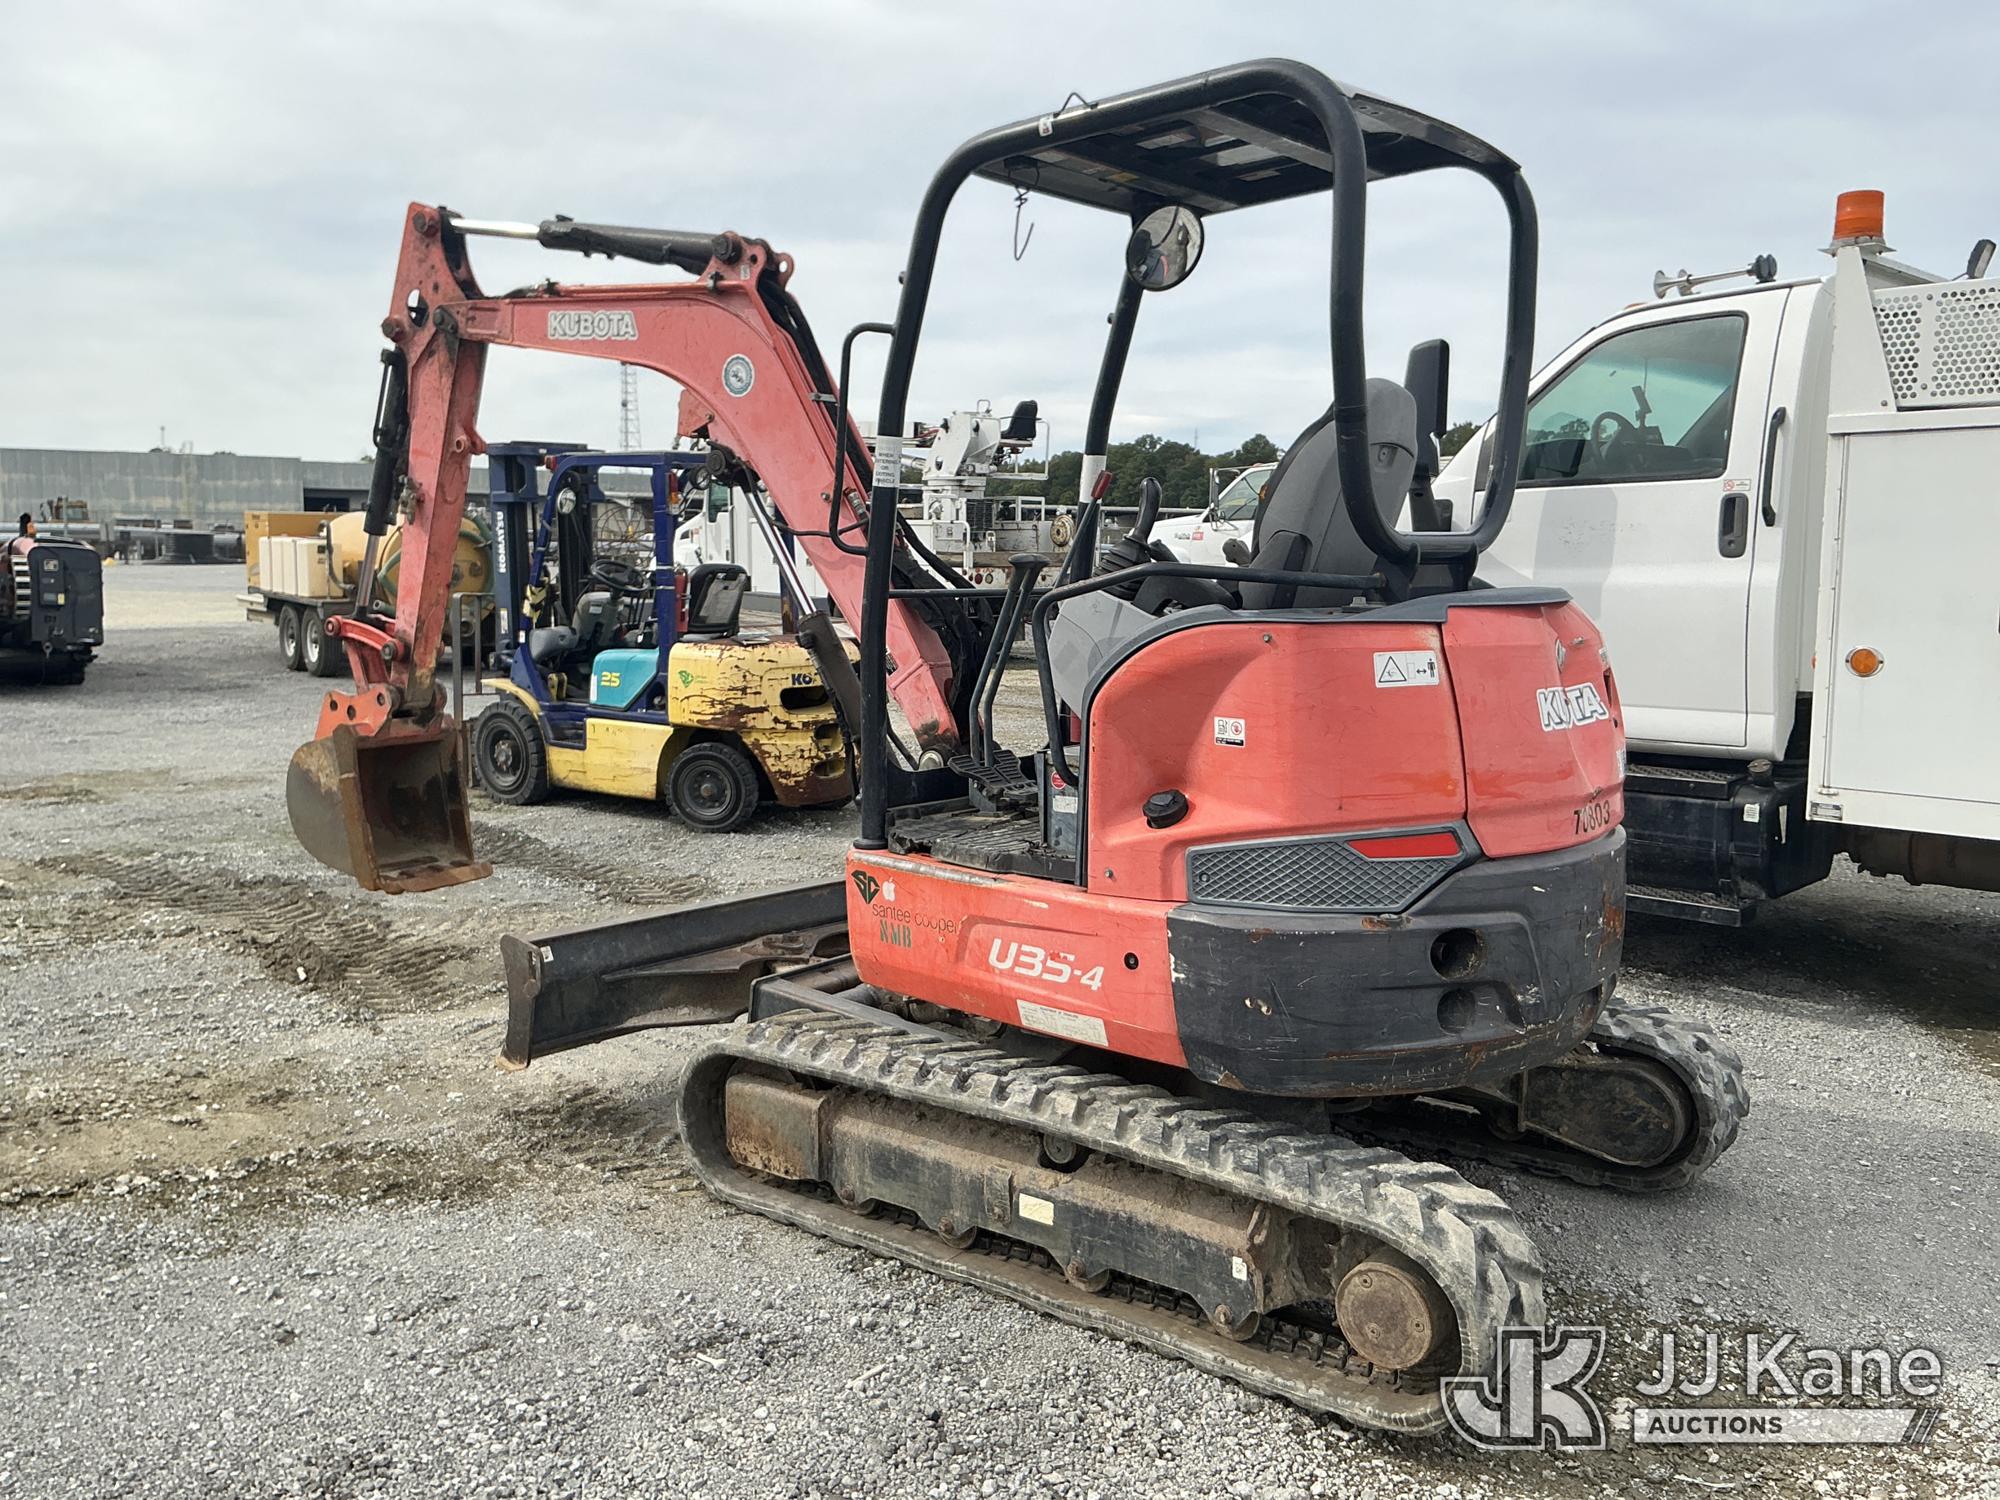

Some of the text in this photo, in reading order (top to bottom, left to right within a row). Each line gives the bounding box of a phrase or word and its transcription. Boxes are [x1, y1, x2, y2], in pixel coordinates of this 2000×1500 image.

[547, 310, 639, 341] KUBOTA
[495, 510, 507, 574] KOMATSU
[601, 671, 621, 687] 25
[1573, 800, 1611, 835] 70803
[872, 903, 911, 923] santee
[988, 938, 1105, 991] U35-4
